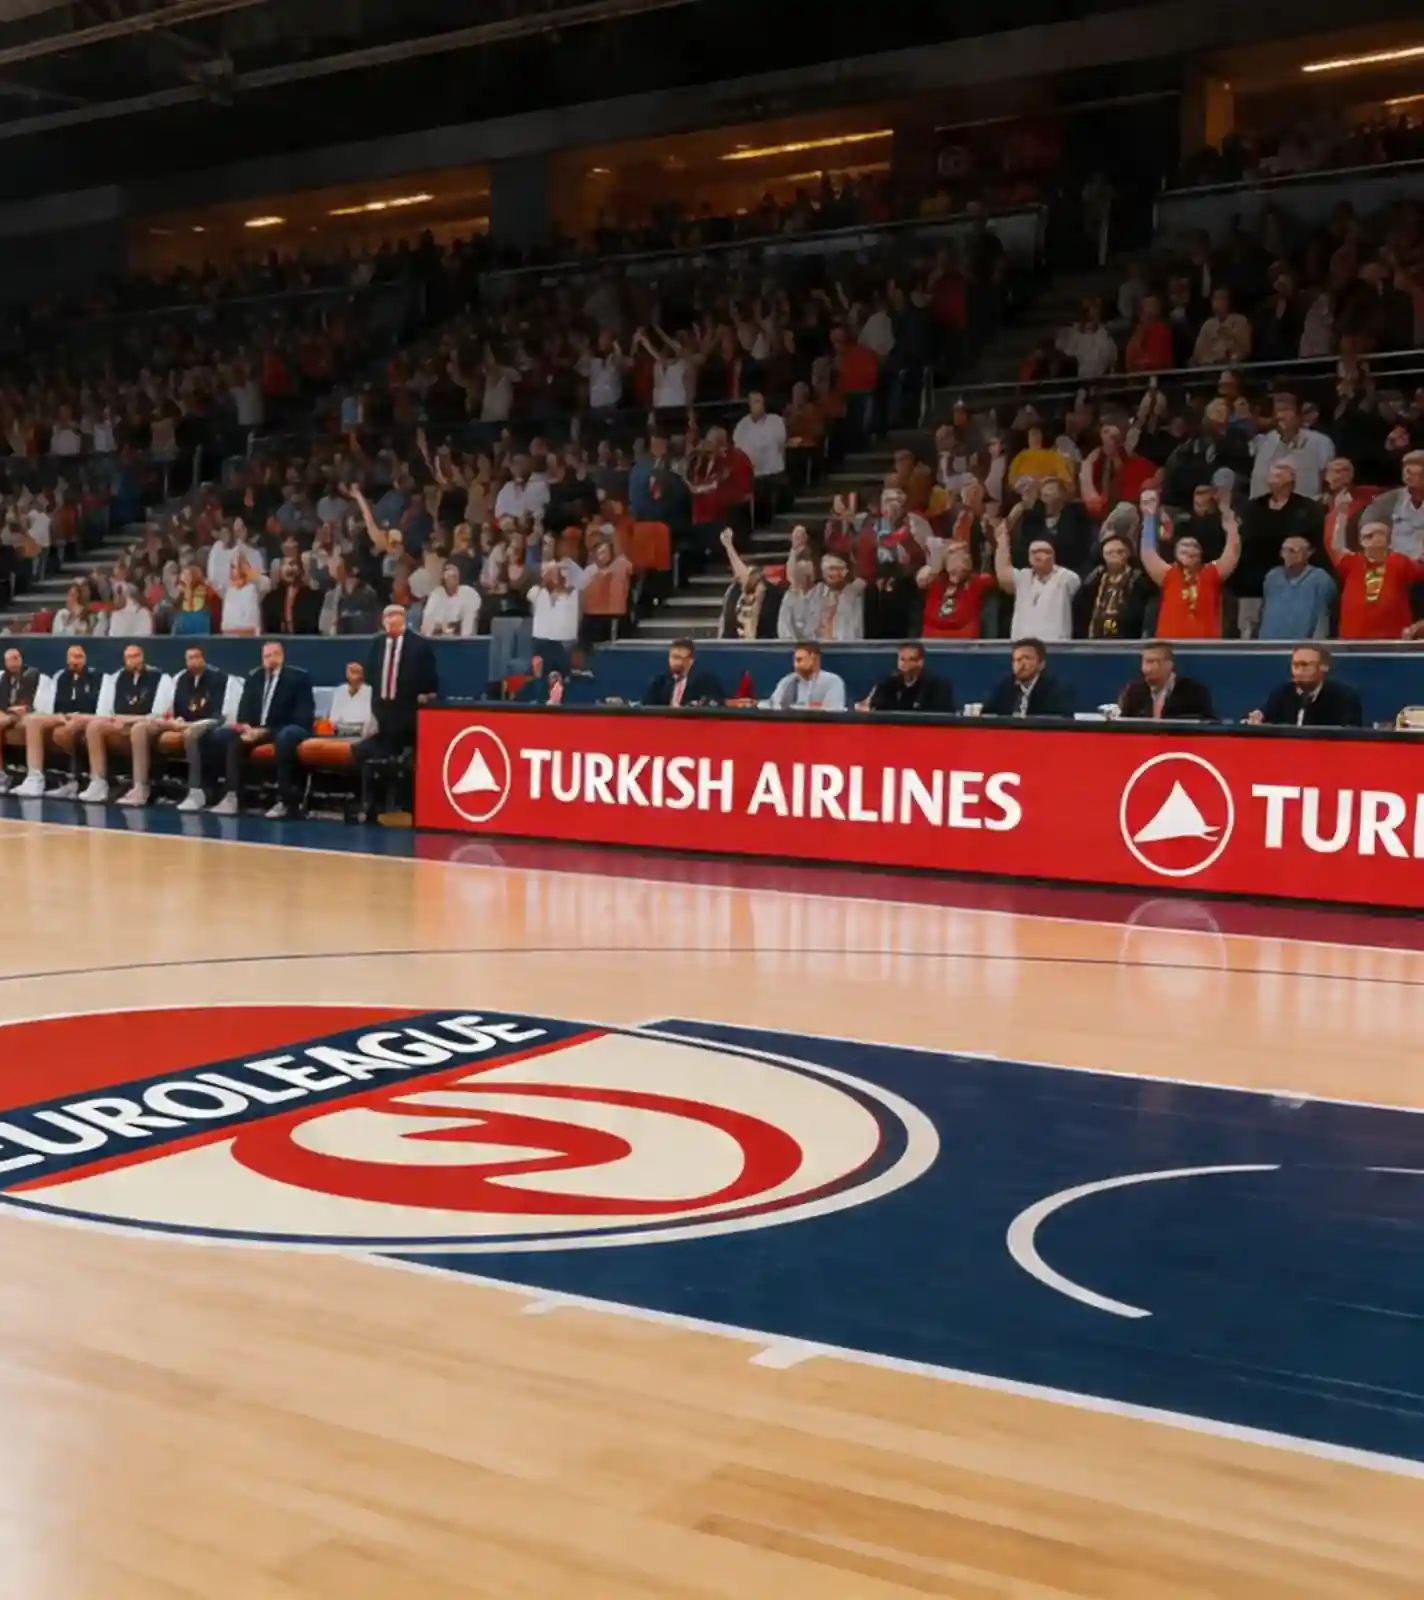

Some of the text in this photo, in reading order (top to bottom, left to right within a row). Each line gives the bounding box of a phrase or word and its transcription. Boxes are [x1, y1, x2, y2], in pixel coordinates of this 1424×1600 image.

[520, 748, 1023, 832] TURKISH AIRLINES
[1251, 783, 1424, 859] TUR
